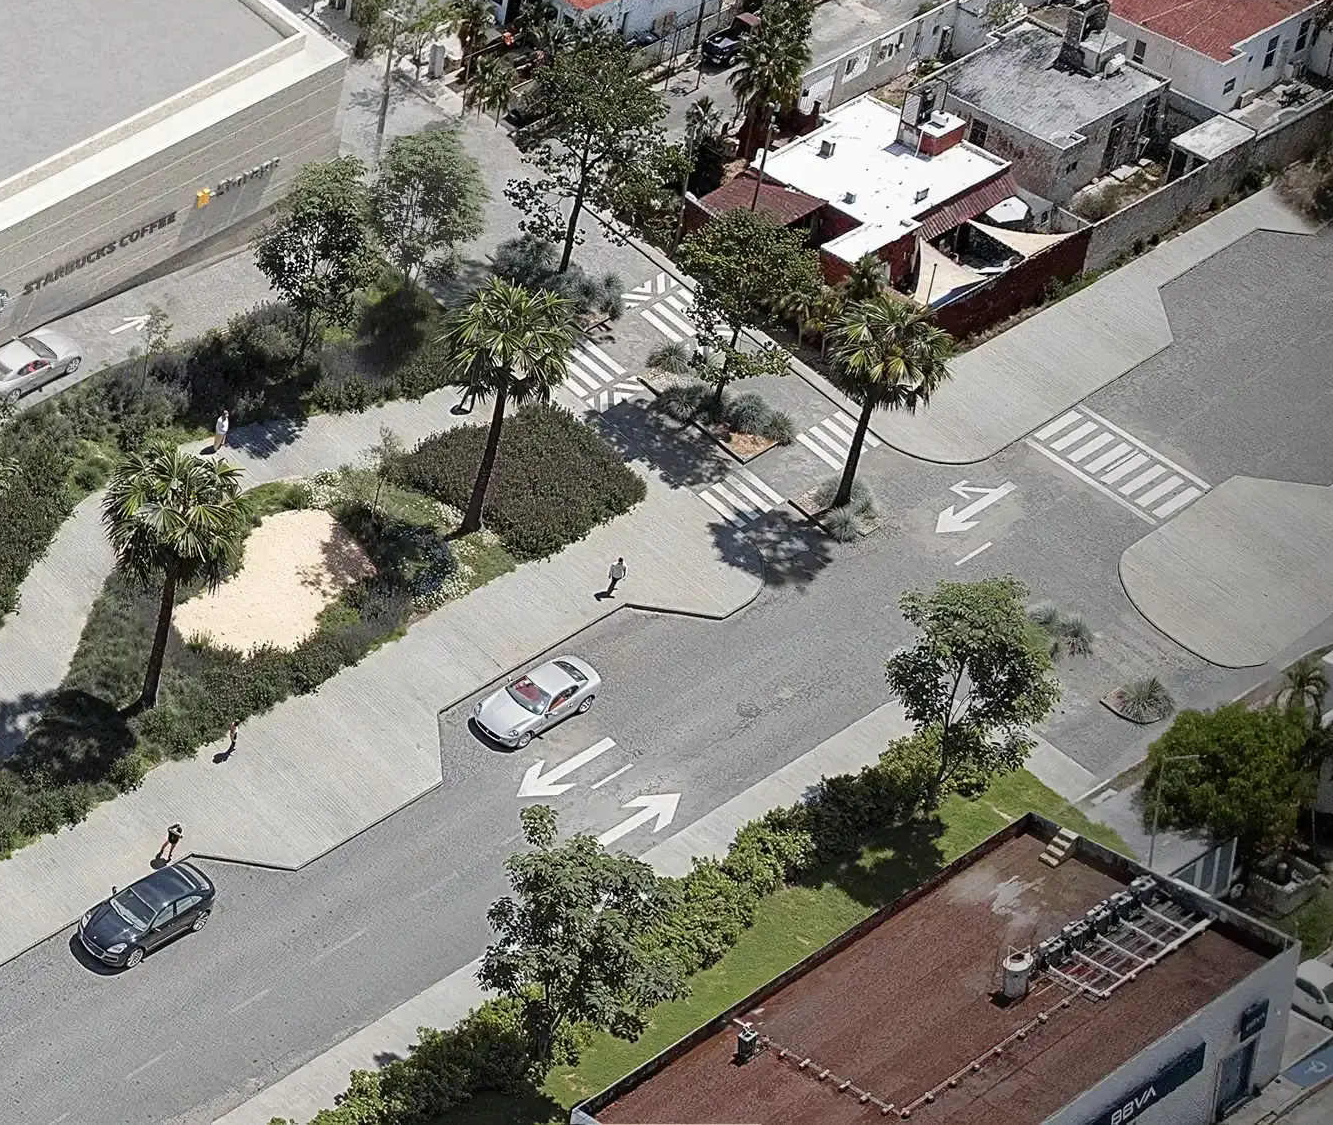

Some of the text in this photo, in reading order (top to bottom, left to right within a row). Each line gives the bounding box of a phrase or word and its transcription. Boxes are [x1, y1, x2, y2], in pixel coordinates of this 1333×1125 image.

[23, 210, 177, 295] STARBUCKS COFFEE
[1111, 1085, 1157, 1125] BBVA
